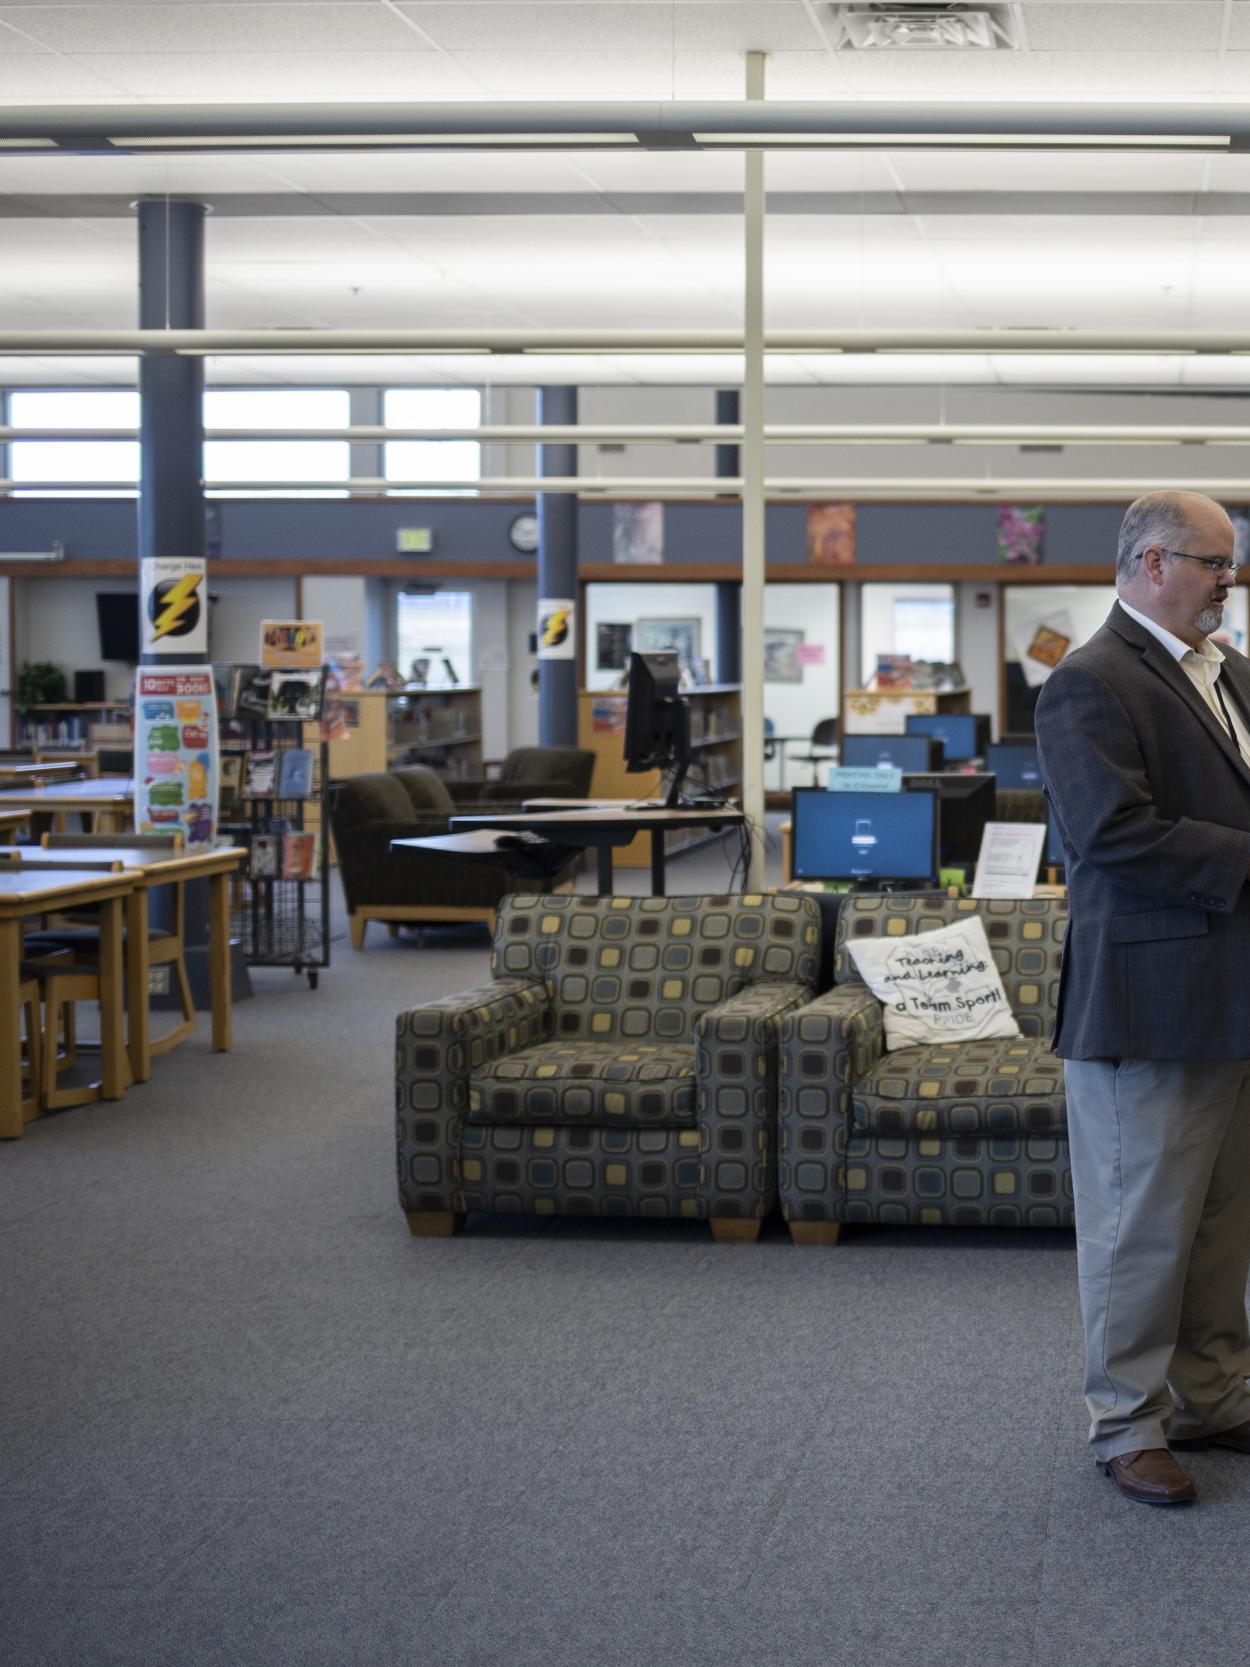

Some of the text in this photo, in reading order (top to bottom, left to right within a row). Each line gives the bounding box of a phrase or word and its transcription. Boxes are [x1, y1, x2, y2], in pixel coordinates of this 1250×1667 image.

[895, 949, 964, 967] Teaching
[884, 971, 914, 983] and
[896, 988, 1001, 1012] a Team Sport!
